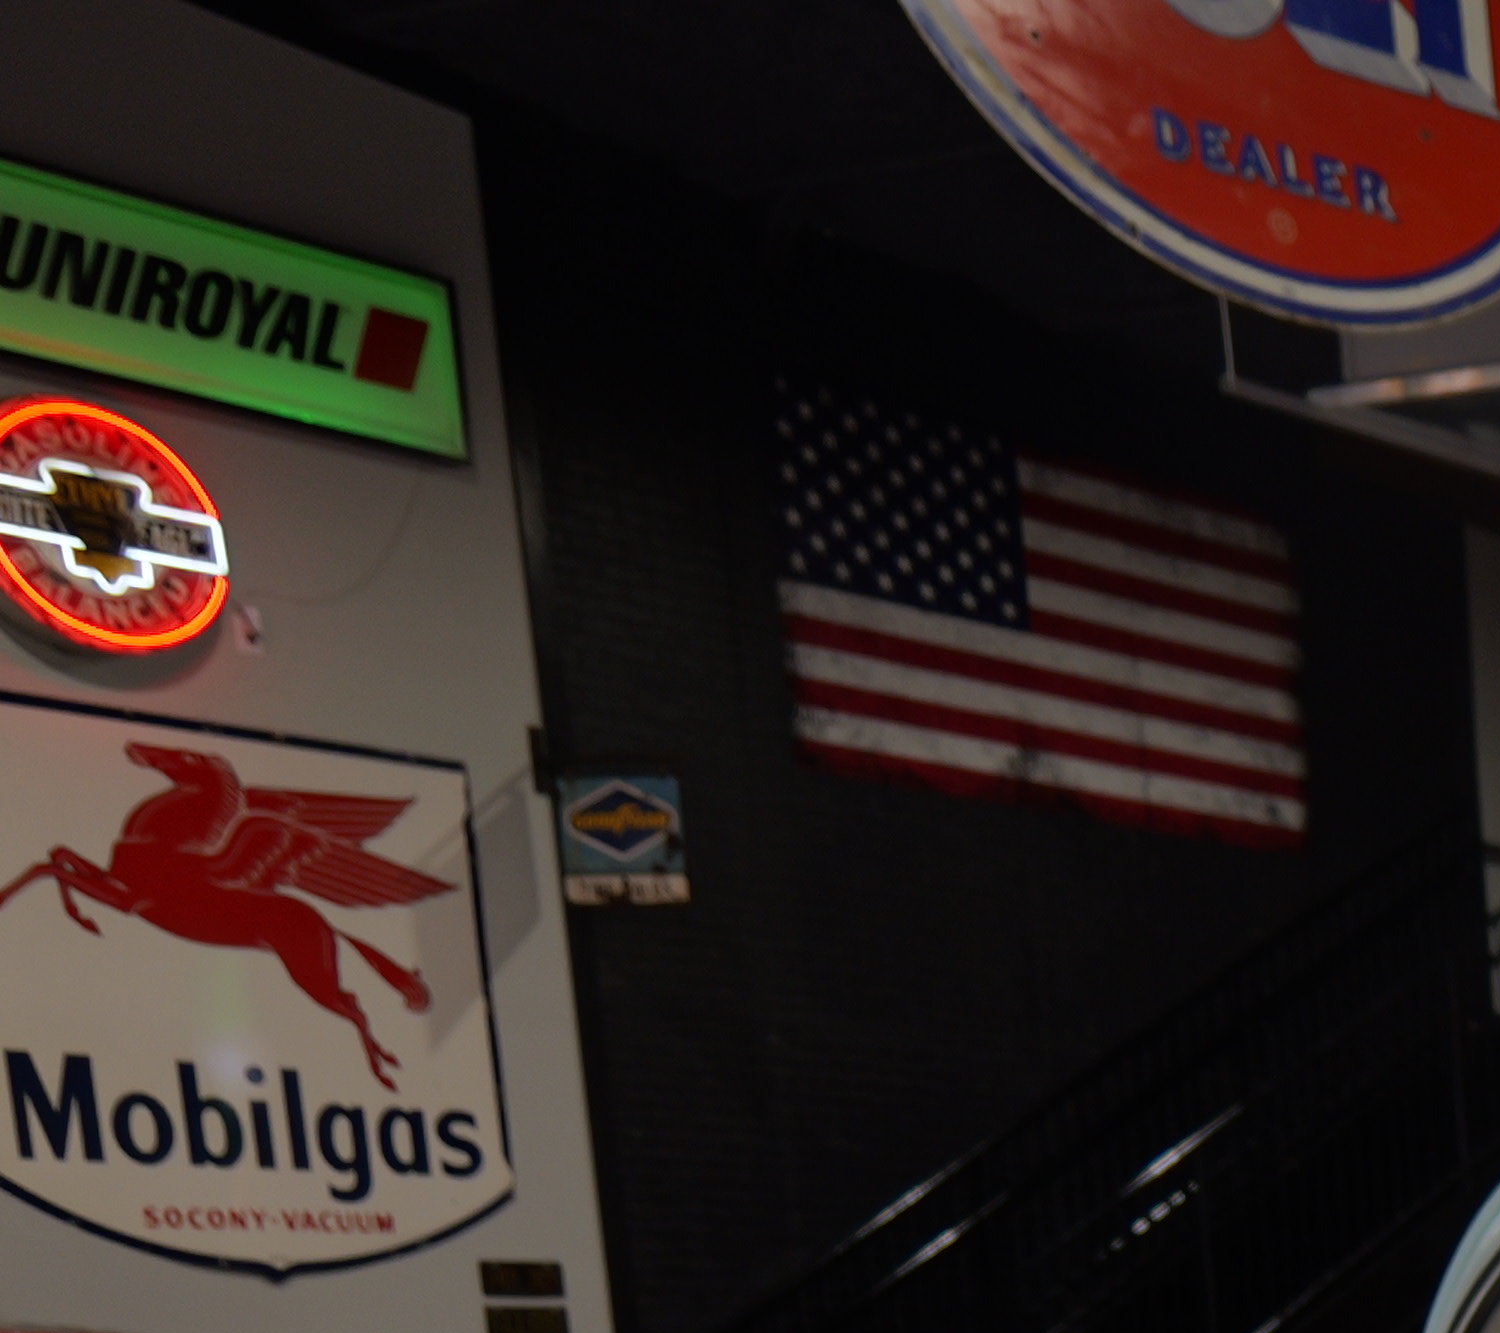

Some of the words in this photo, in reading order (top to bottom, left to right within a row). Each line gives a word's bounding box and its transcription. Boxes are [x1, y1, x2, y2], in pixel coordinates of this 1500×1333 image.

[1150, 106, 1397, 222] DEALER
[0, 215, 346, 373] UNIROYAL
[3, 1048, 486, 1202] Mobilgas
